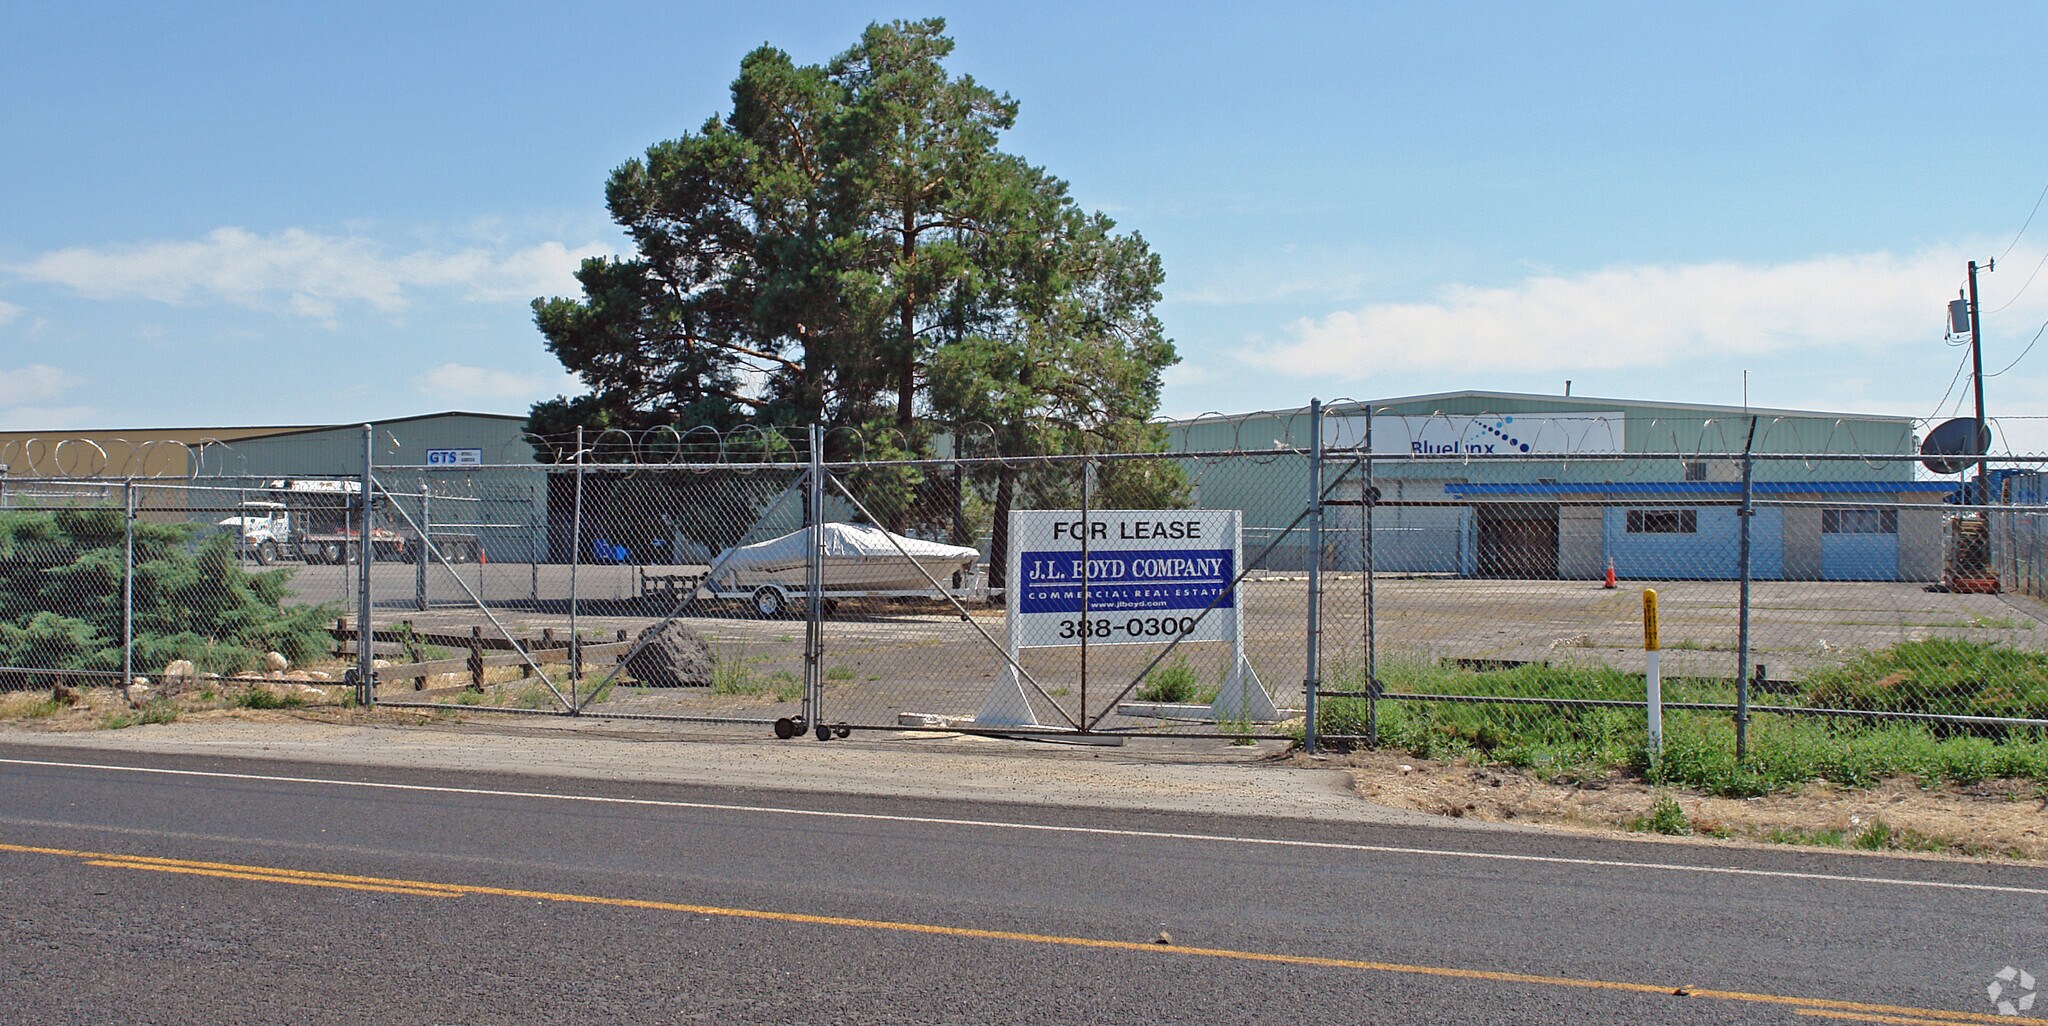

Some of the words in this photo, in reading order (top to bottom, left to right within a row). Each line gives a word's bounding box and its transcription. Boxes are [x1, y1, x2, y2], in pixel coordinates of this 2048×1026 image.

[429, 451, 457, 463] GTS
[1053, 521, 1108, 540] FOR
[1120, 521, 1201, 539] LEASE
[1029, 560, 1066, 580] J.L.
[1071, 559, 1126, 579] BOYD
[1132, 558, 1223, 578] COMPANY
[1028, 590, 1129, 600] COMMERCIAL
[1134, 589, 1169, 598] REAL
[1091, 600, 1167, 609] www.jlboyd.com
[1059, 616, 1196, 639] 388-0300
